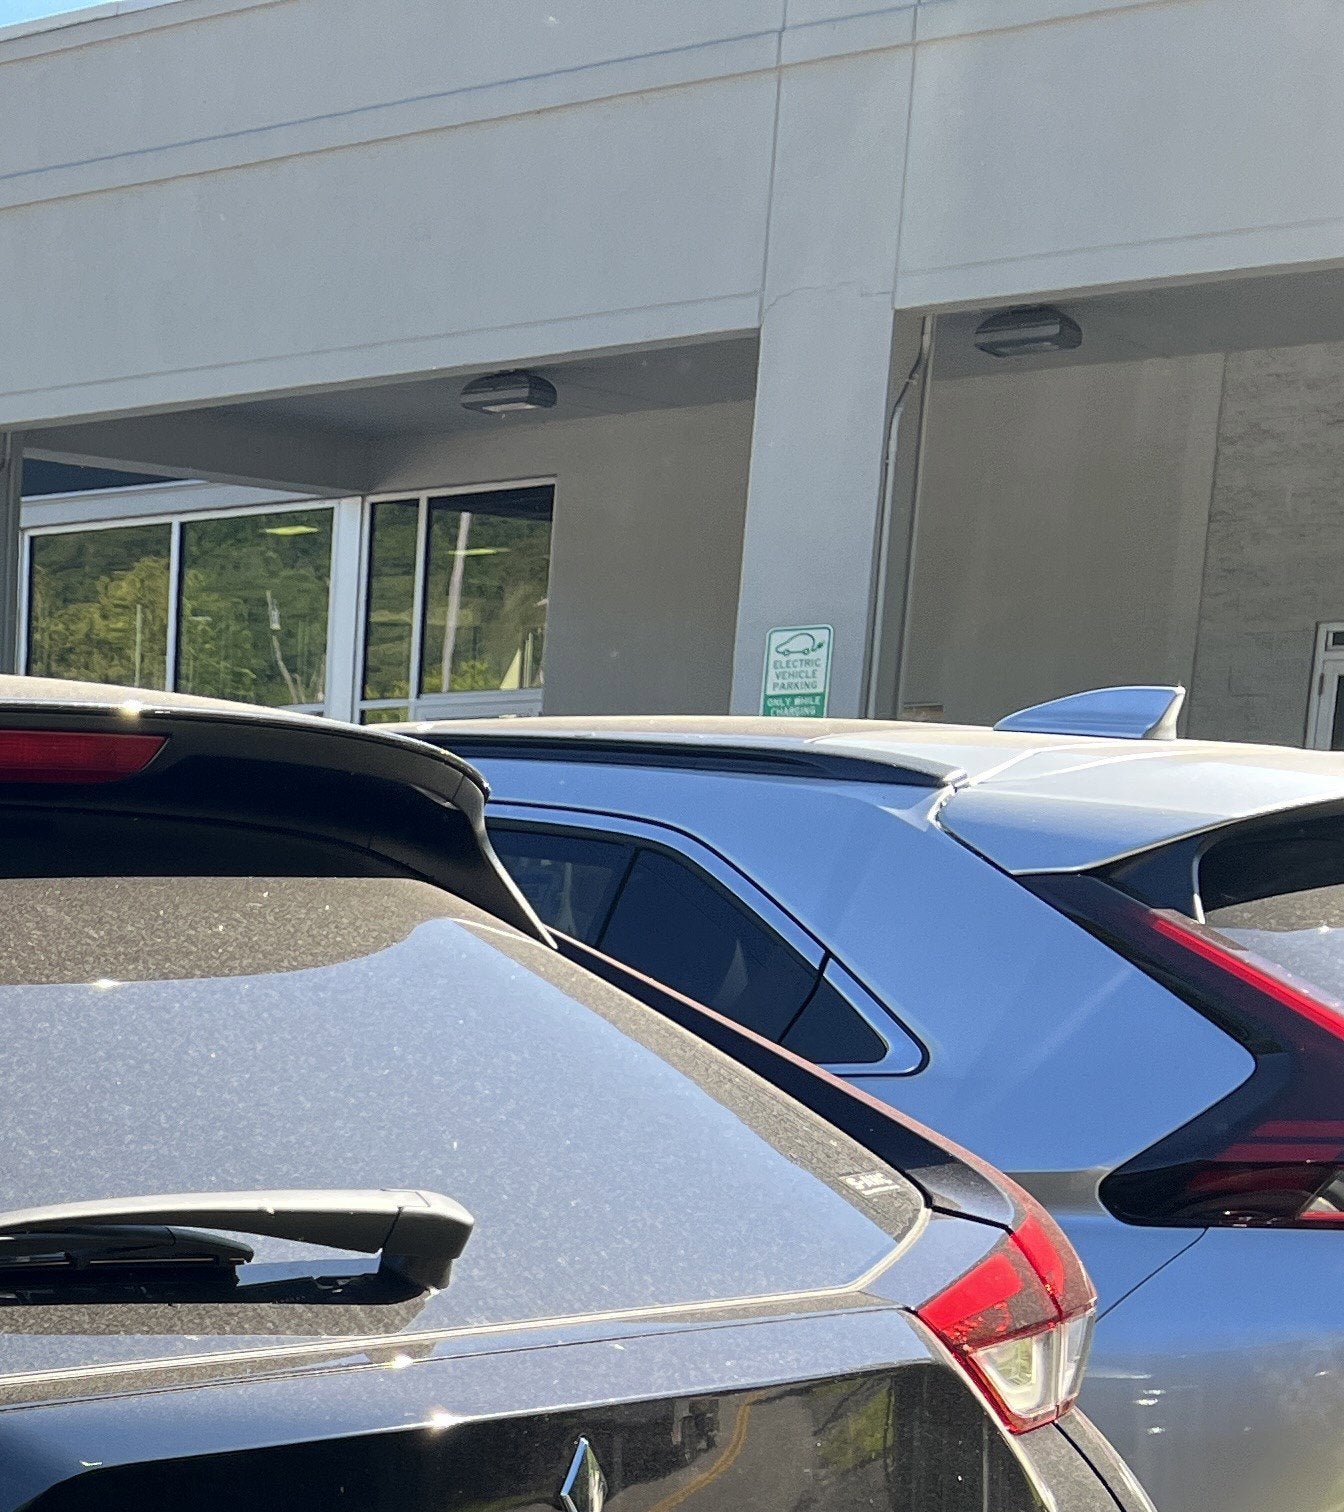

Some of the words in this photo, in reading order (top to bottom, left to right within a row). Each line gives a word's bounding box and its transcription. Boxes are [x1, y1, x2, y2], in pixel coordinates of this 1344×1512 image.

[773, 658, 822, 670] ELECTRIC
[774, 669, 818, 680] VEHICLE
[772, 680, 818, 691] PARKING
